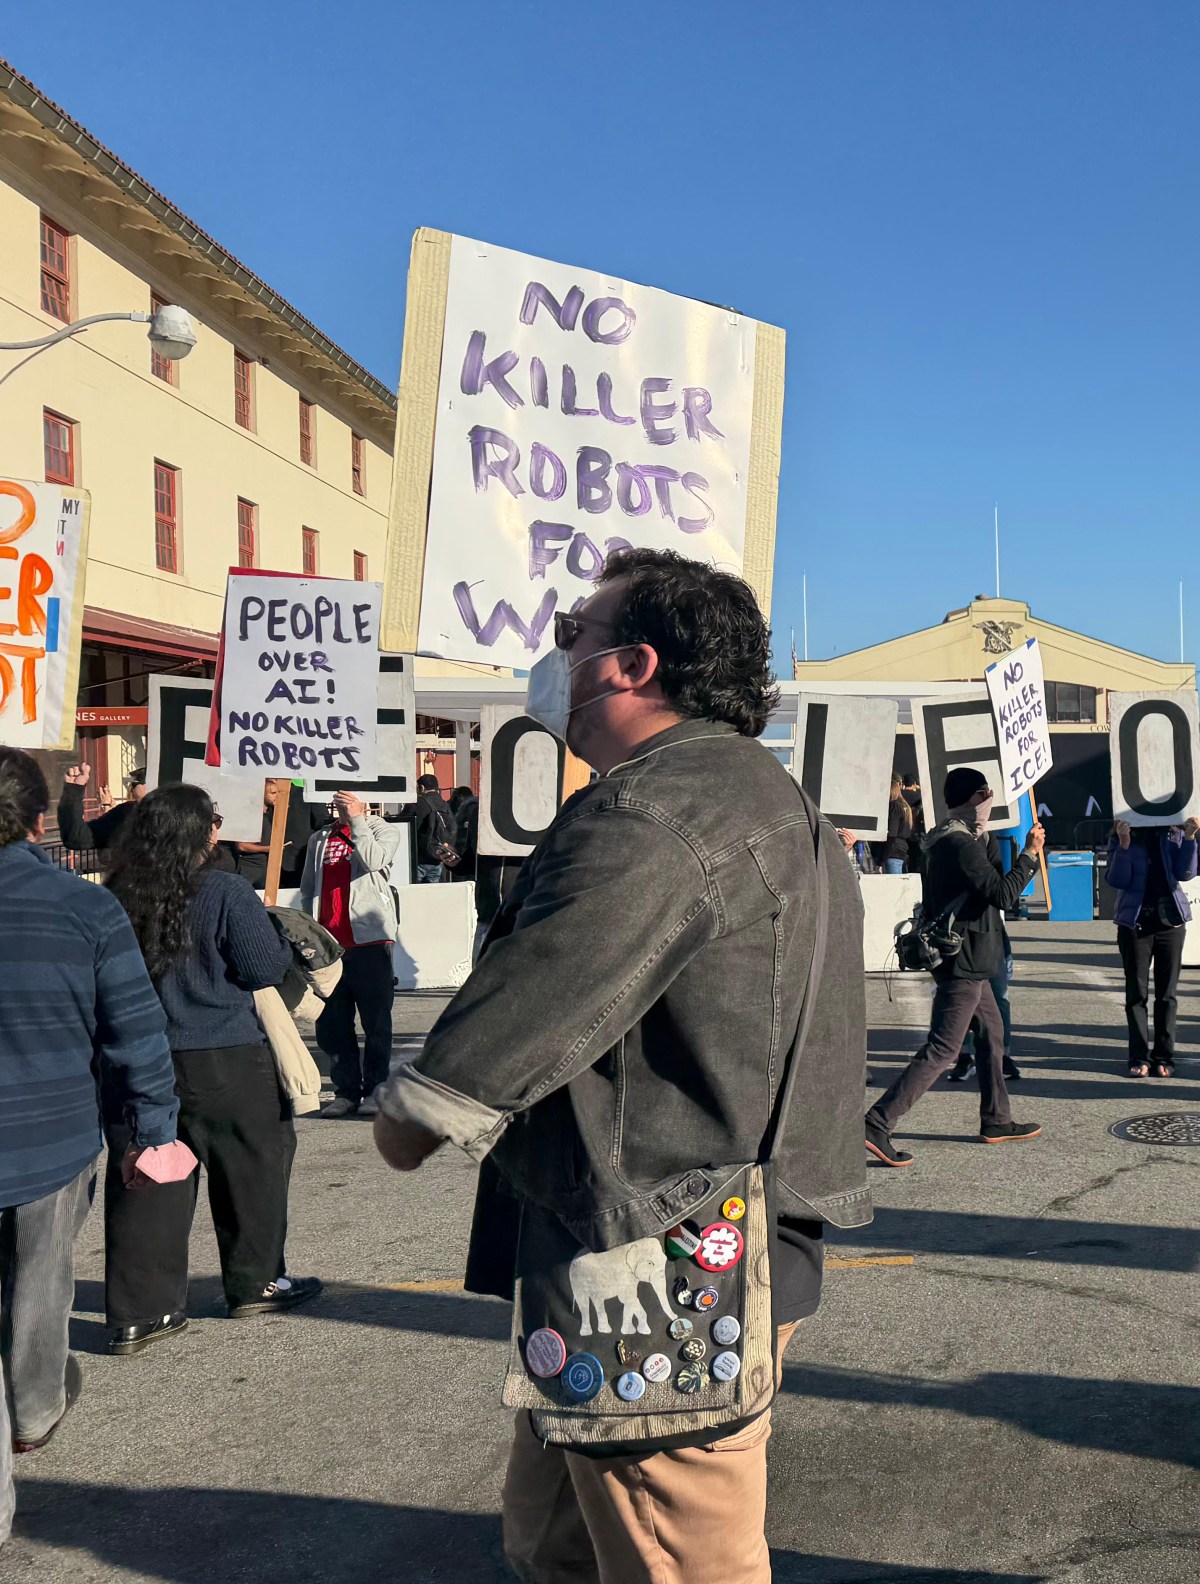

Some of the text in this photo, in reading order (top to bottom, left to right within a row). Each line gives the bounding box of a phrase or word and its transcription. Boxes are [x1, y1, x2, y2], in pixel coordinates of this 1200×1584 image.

[518, 281, 637, 345] NO
[459, 330, 726, 446] KILLER
[466, 424, 715, 534] ROBOTS
[238, 596, 372, 643] PEOPLE
[258, 650, 336, 673] OVER
[1003, 662, 1024, 691] NO
[264, 678, 336, 704] AI!
[999, 683, 1039, 729] KILLER
[229, 712, 365, 740] NO KILLER
[1005, 700, 1042, 744] ROBOTS
[1090, 724, 1112, 732] COW
[238, 737, 361, 771] ROBOTS
[1017, 730, 1038, 757] FOR
[1010, 742, 1047, 791] ICE!
